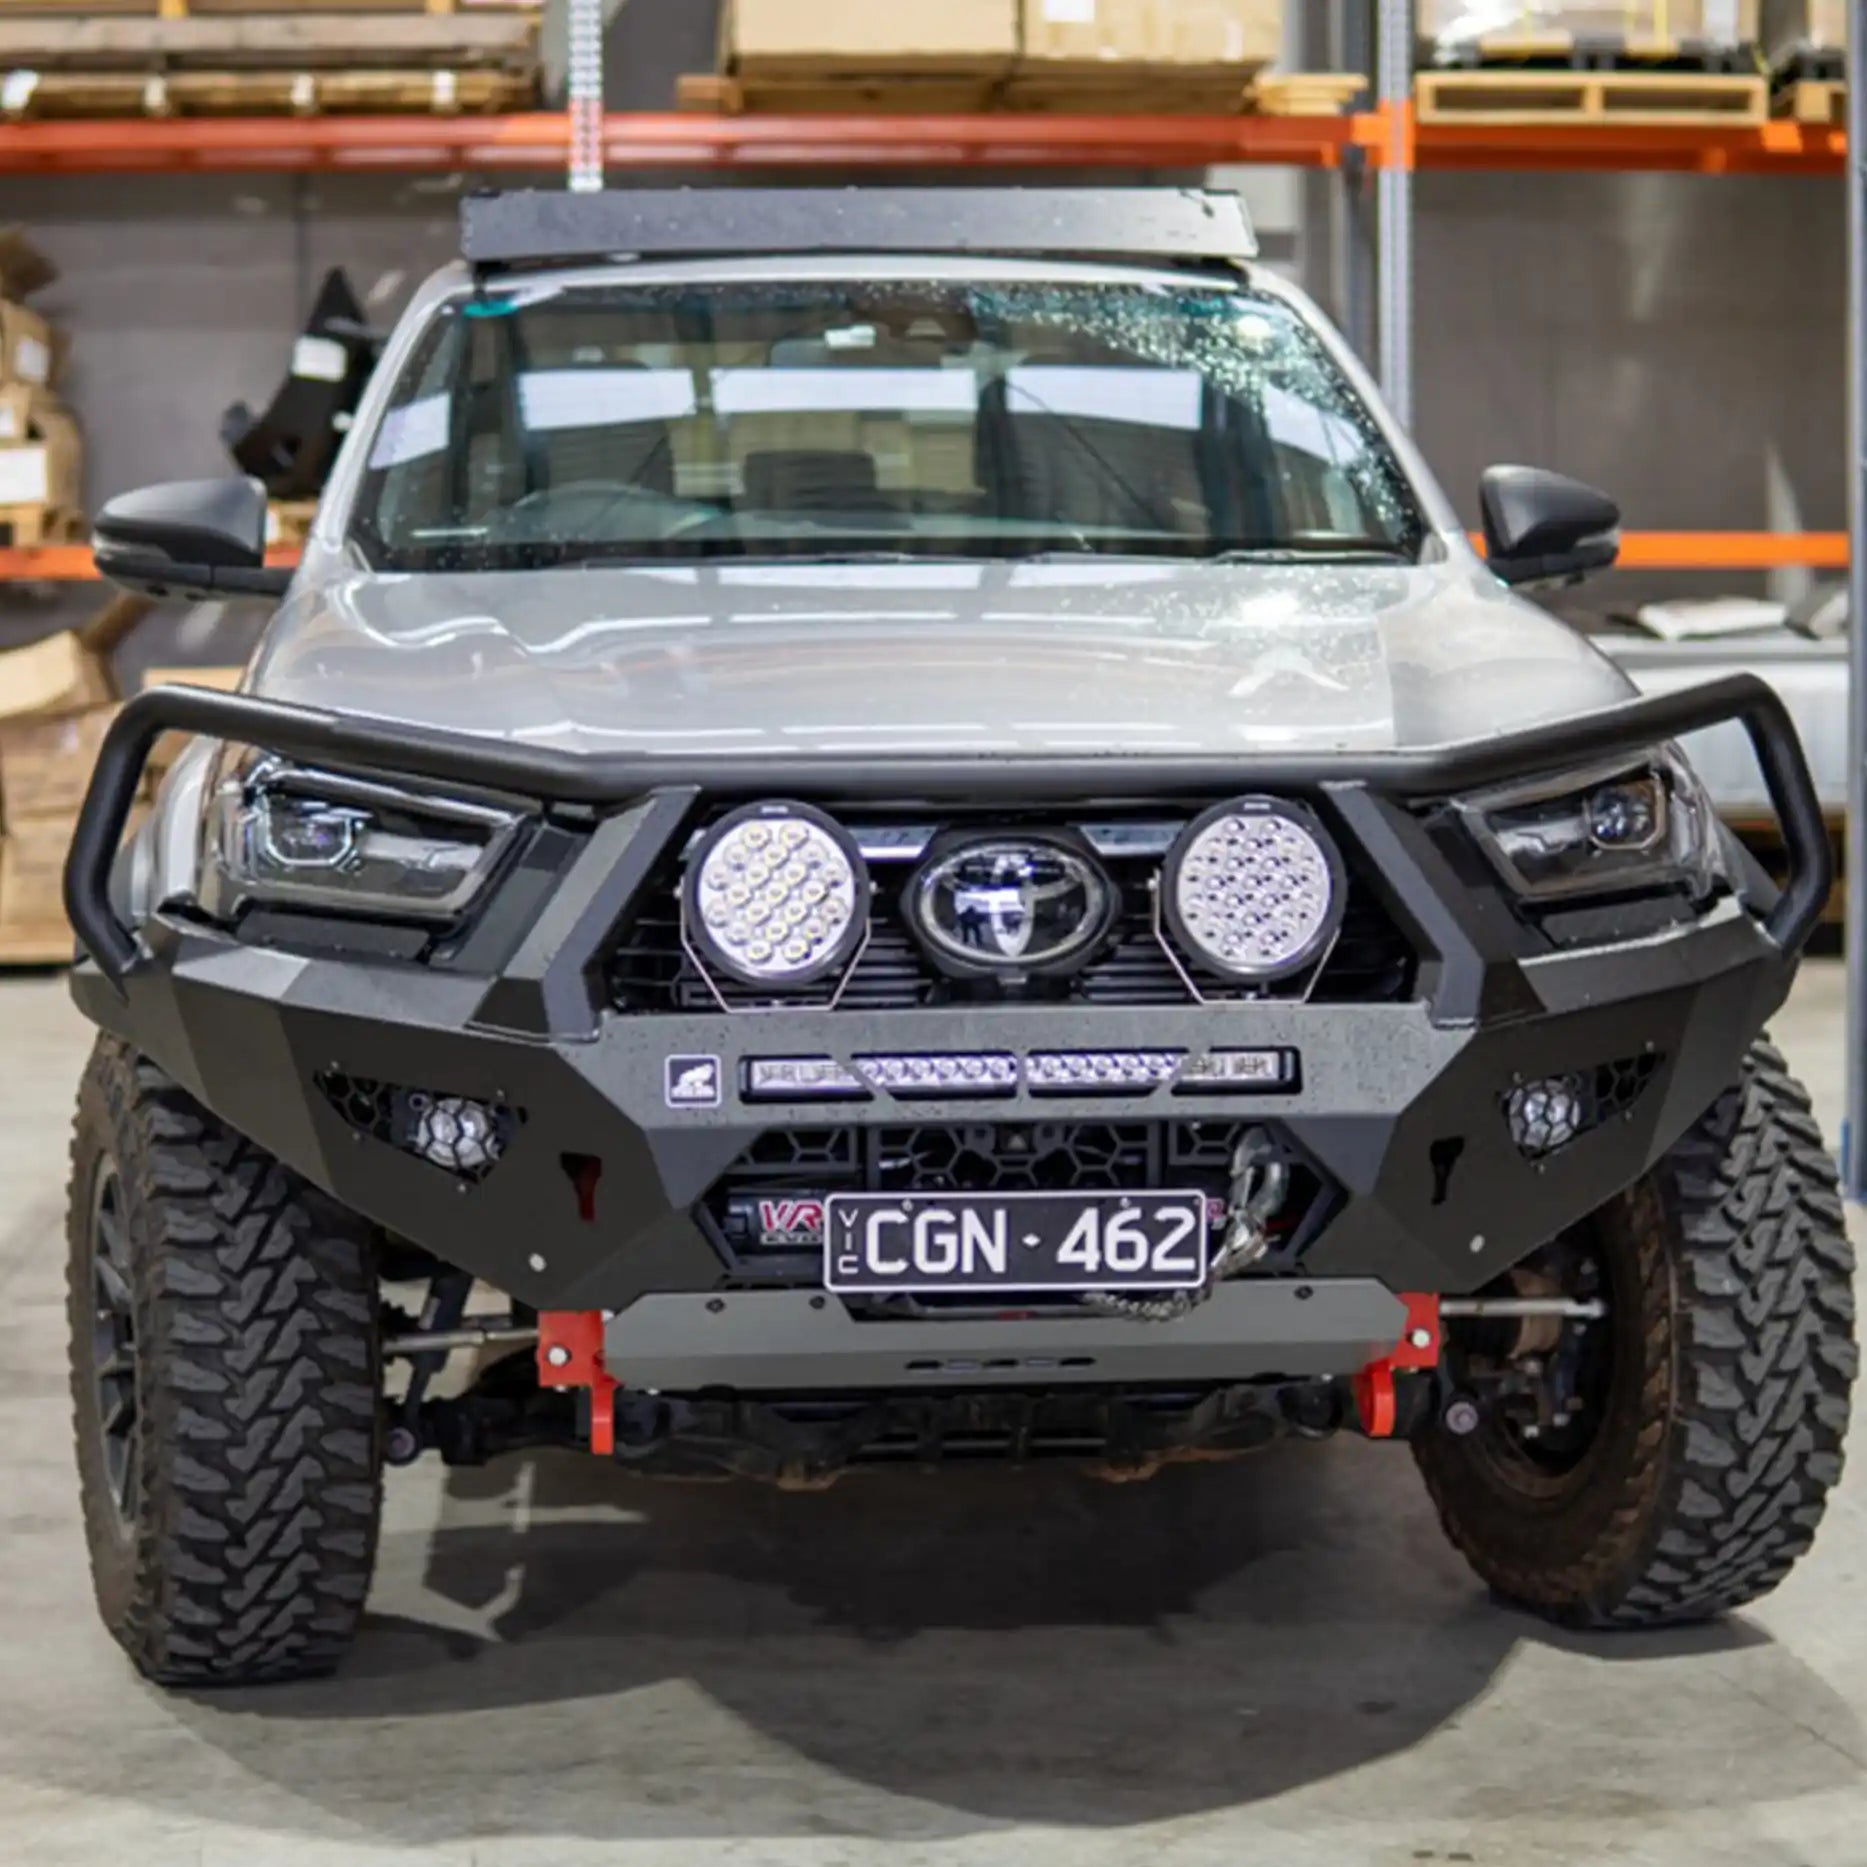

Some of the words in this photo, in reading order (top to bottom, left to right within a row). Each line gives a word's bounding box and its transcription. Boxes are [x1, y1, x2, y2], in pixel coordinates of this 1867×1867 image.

[838, 1208, 859, 1274] VIC
[866, 1209, 1006, 1274] CGN
[1056, 1207, 1196, 1272] 462
